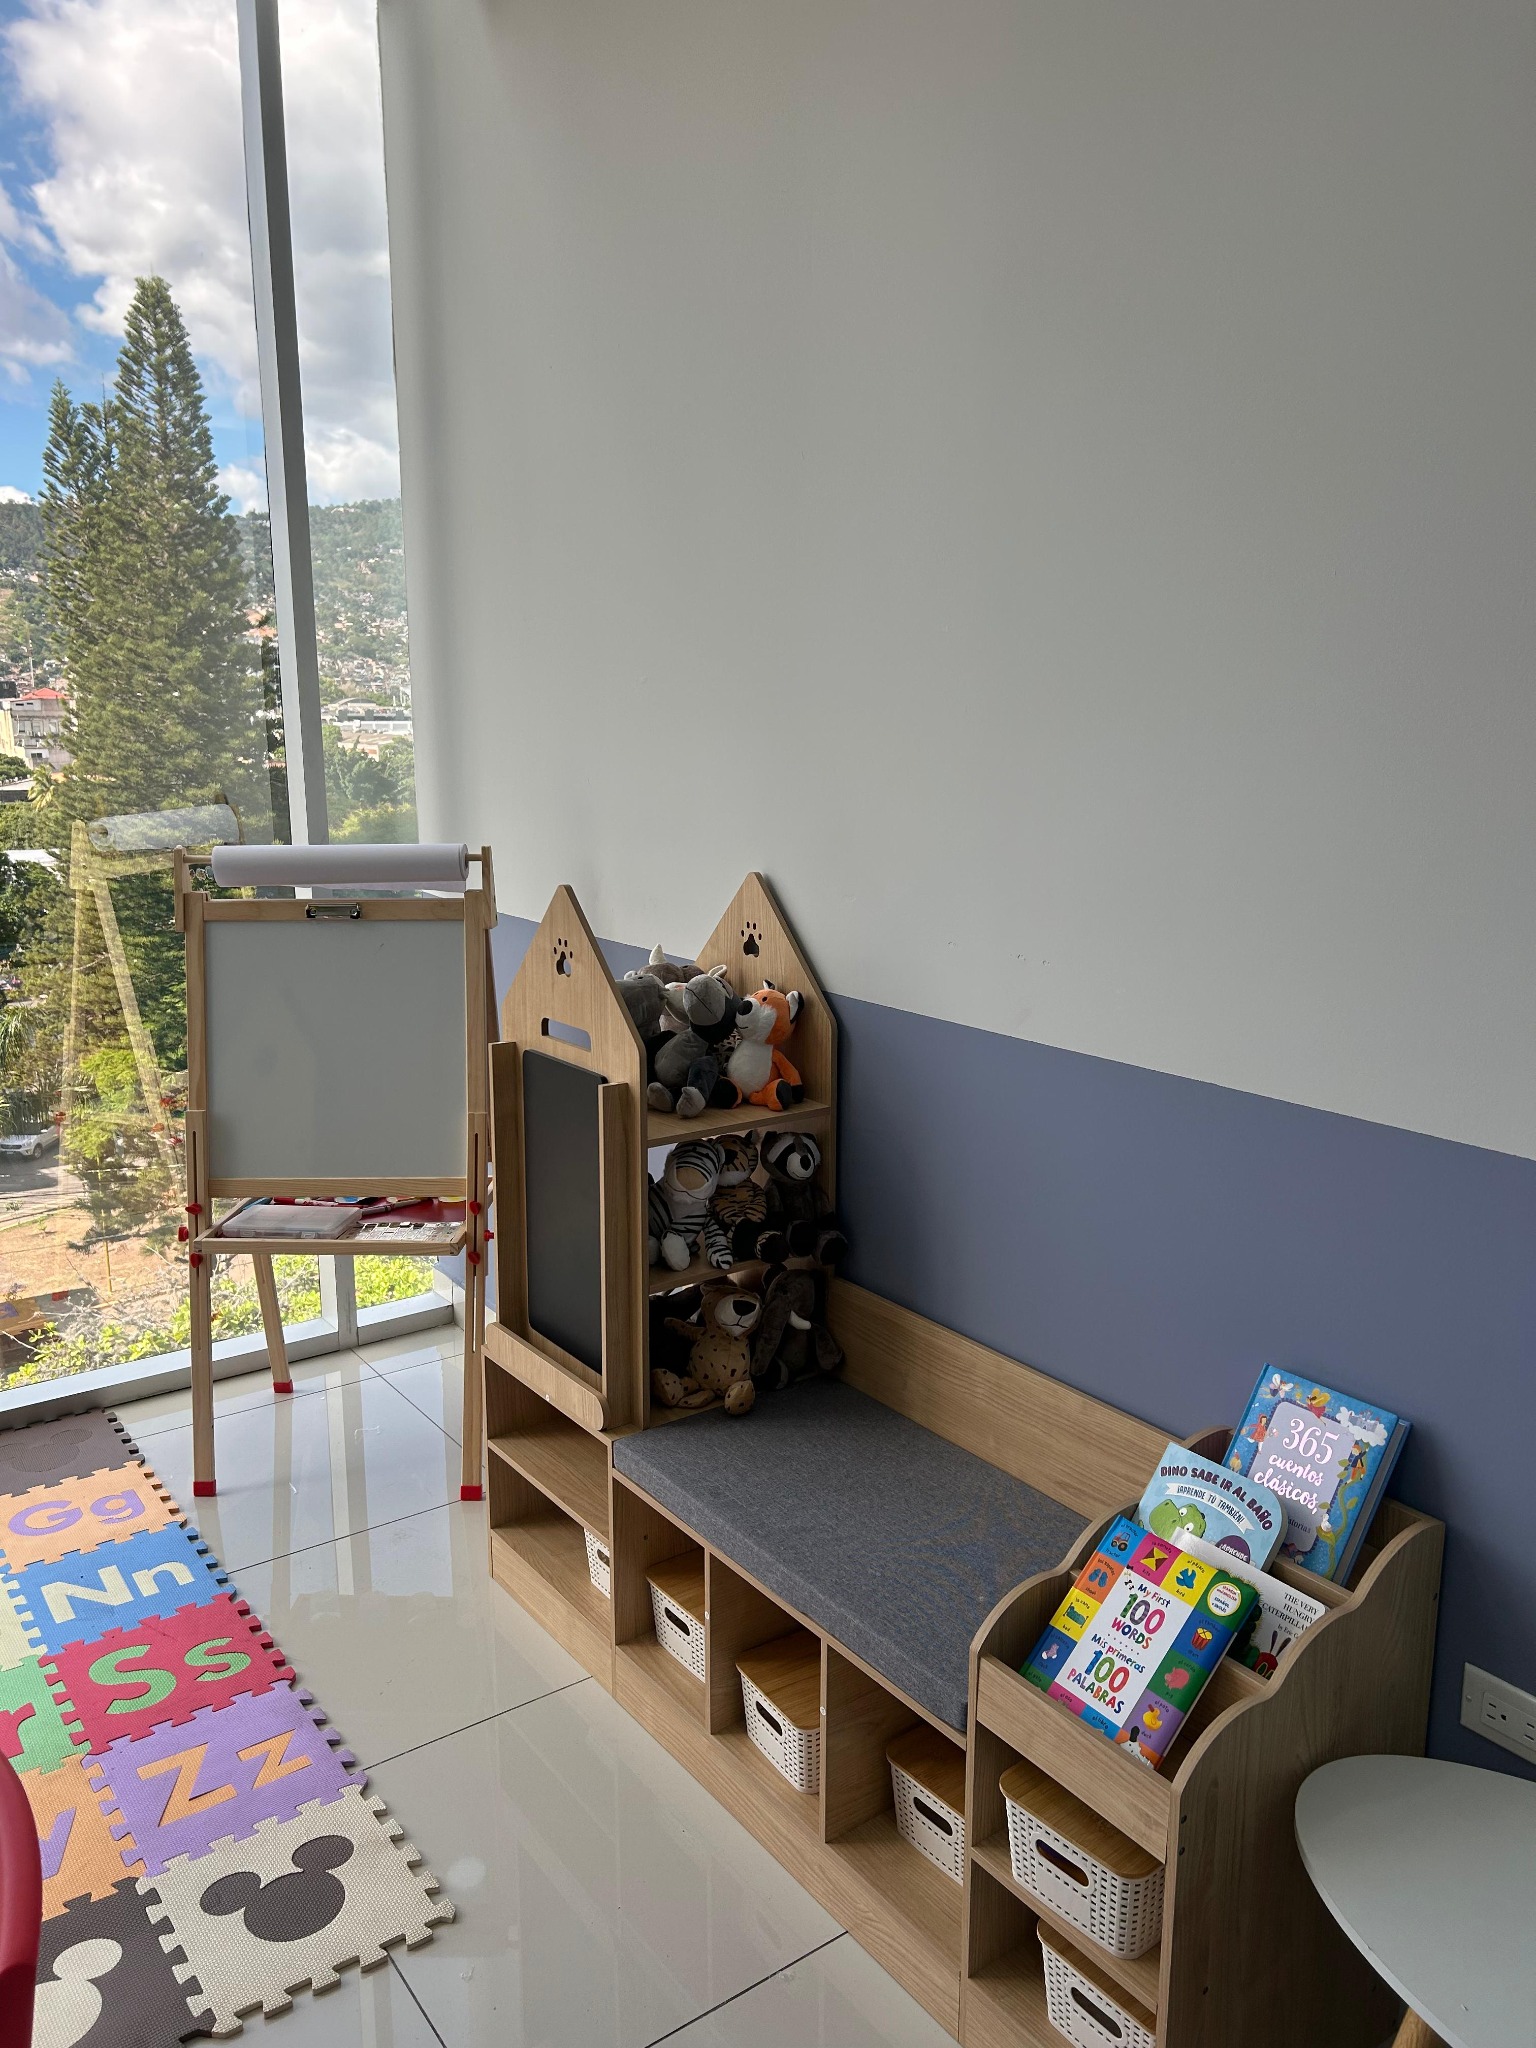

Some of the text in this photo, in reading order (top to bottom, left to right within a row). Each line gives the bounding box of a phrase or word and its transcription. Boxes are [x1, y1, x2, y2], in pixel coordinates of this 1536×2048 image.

[1282, 1418, 1340, 1465] 365
[1268, 1454, 1324, 1487] cuentos
[7, 1488, 146, 1538] Gg
[1160, 1465, 1273, 1531] DINO SABE IR AL BAÑO
[1177, 1485, 1245, 1525] ¡APRENDE TÚ TAMBIÉN!
[40, 1561, 196, 1624] Nn
[1120, 1592, 1166, 1635] 100
[1138, 1583, 1171, 1608] My First
[1283, 1603, 1316, 1625] HUNGRY
[1284, 1592, 1320, 1616] THE VERY
[1111, 1616, 1153, 1650] WORDS
[1278, 1623, 1283, 1632] by
[1084, 1650, 1130, 1693] 100
[1091, 1633, 1108, 1650] Mis
[1105, 1644, 1146, 1674] primeras
[87, 1637, 251, 1715] Ss
[1067, 1668, 1125, 1714] PALABRAS
[136, 1729, 312, 1827] Zz
